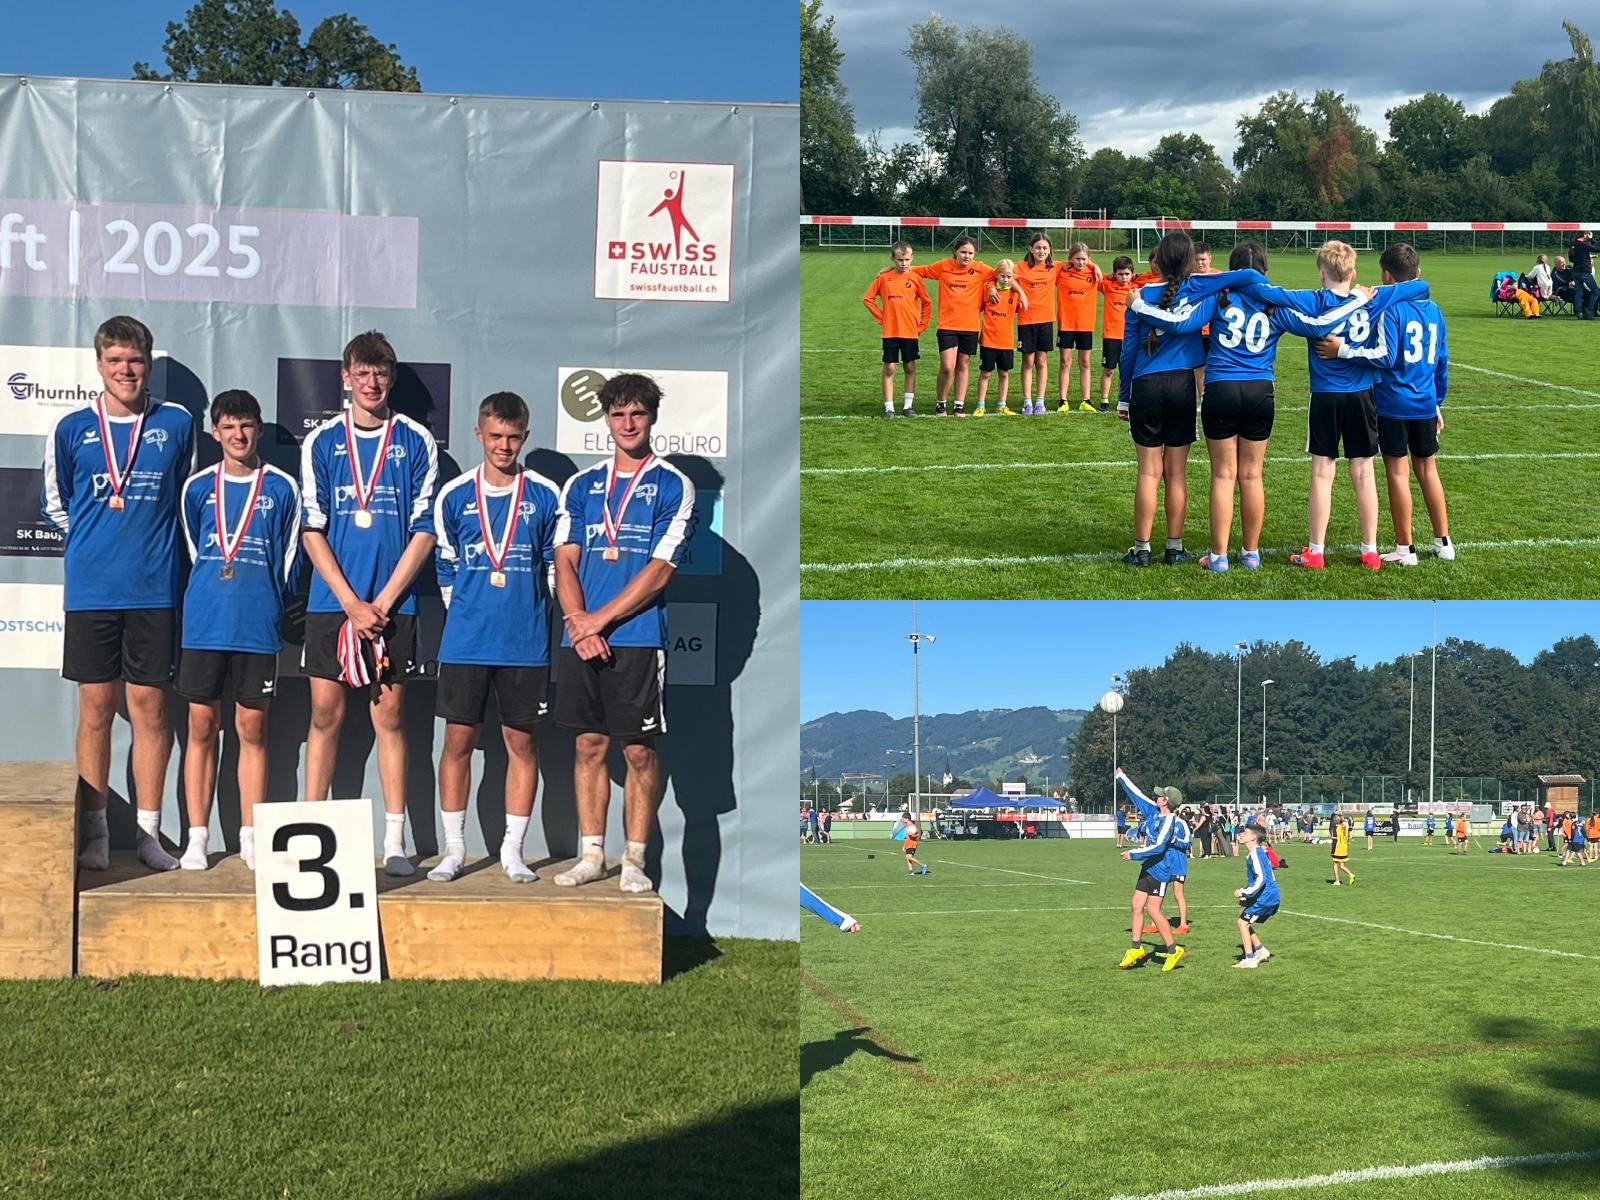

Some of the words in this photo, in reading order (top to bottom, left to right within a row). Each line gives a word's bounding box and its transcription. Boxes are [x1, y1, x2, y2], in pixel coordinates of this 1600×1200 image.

[104, 219, 262, 279] 2025
[631, 242, 717, 262] SWISS
[630, 262, 718, 277] FAUSTBALL
[629, 283, 718, 294] swissfaustball.ch
[1218, 307, 1270, 353] 30
[1404, 320, 1438, 364] 31
[16, 529, 33, 539] SK
[673, 636, 703, 651] AG
[272, 822, 364, 911] 3.
[270, 935, 372, 974] Rang
